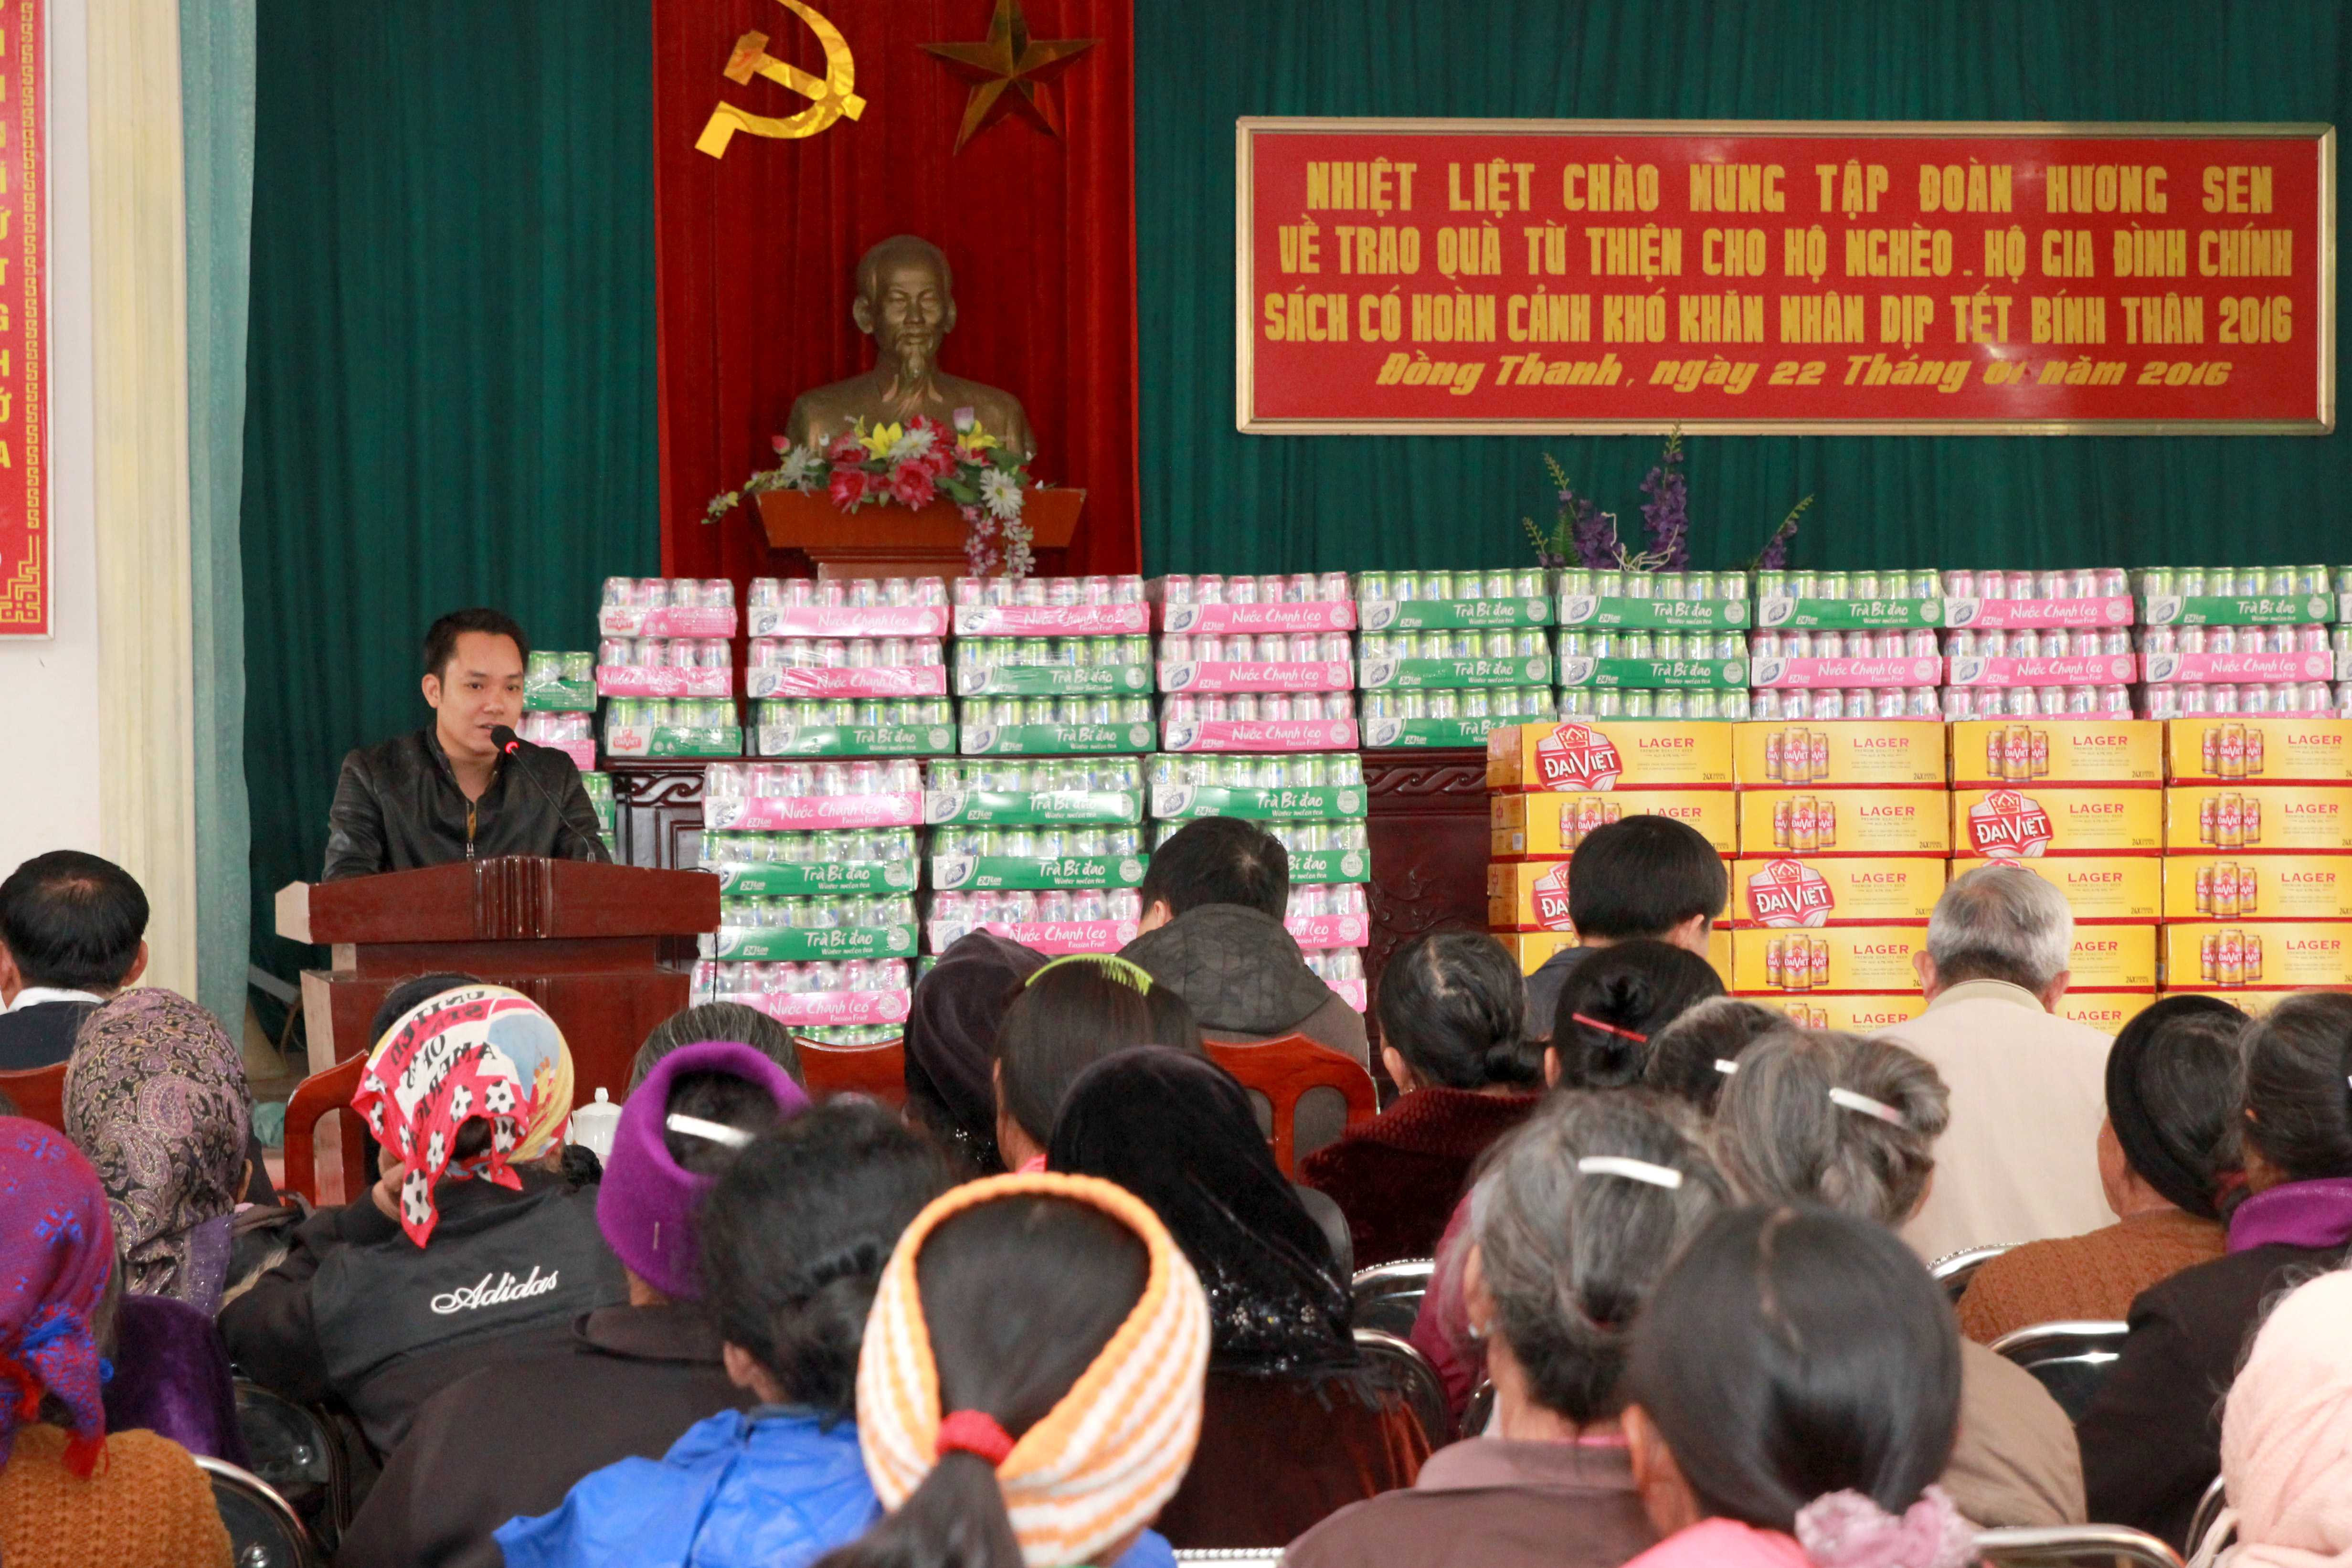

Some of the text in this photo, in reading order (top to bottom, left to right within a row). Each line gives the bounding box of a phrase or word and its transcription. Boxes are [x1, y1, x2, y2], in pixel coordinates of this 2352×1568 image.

[1307, 157, 1418, 217] NHIỆT
[1449, 158, 1535, 218] LIỆT
[1563, 156, 1659, 212] CHÀO
[1816, 160, 1889, 220] TẬP
[1919, 158, 2013, 213] ĐOÀN
[2046, 165, 2167, 213] HƯƠNG
[2203, 166, 2272, 213] SEN
[1279, 214, 1320, 273] VỀ
[1335, 226, 1420, 275] TRAO
[1437, 220, 1501, 280] QUÀ
[1524, 220, 1566, 275] TỪ
[1585, 223, 1682, 282] THIỆN
[1703, 228, 1766, 276] CHO
[1785, 224, 1827, 283] HỘ
[1846, 223, 1952, 277] NGHÈO
[1984, 225, 2026, 283] HỘ
[2042, 229, 2094, 277] GIA
[2113, 222, 2186, 276] ĐÌNH
[2199, 222, 2292, 276] CHÍNH
[1264, 284, 2292, 349] SÁCH CÓ HOÀN CẢNH KHÓ KHĂN NHÂN DỊP TẾT BÍNH THÂN 2016
[1377, 350, 2232, 395] Đồng Thanh, ngày 22 Tháng 01 năm 2016
[1454, 603, 1515, 617] Trà Bí đao
[1652, 602, 1712, 616] Trà Bí đao
[1849, 602, 1907, 617] Trà Bí đao
[2044, 604, 2077, 617] Chanh
[2237, 599, 2295, 614] Trà Bí đao
[1265, 609, 1300, 624] Chanh
[1263, 667, 1298, 681] Chanh
[1453, 661, 1513, 676] Trà Bí đao
[1651, 662, 1711, 677] Trà Bí đao
[1851, 662, 1885, 676] Chanh
[2049, 661, 2083, 674] Chanh
[1056, 728, 1116, 742] Trà Bí đao
[1265, 725, 1300, 739] Chanh
[1639, 739, 1694, 747] LAGER
[1854, 738, 1909, 747] LAGER
[2074, 736, 2127, 745] LAGER
[2288, 736, 2342, 744] LAGER
[1257, 791, 1322, 809] Trà Bí đao
[818, 803, 857, 817] Chanh
[1646, 808, 1701, 817] LAGER
[1860, 806, 1915, 816] LAGER
[2069, 804, 2124, 813] LAGER
[2285, 804, 2338, 813] LAGER
[1039, 860, 1105, 876] Trà Bí đao
[1303, 856, 1326, 870] đao
[802, 865, 870, 880] Trà Bí đao
[1851, 873, 1907, 882] LAGER
[2068, 873, 2122, 881] LAGER
[2281, 873, 2335, 881] LAGER
[805, 930, 873, 946] Trà Bí đao
[1045, 927, 1083, 940] Chanh
[1854, 945, 1908, 954] LAGER
[2286, 941, 2340, 950] LAGER
[806, 1000, 845, 1015] Chanh
[1853, 1014, 1908, 1023] LAGER
[2066, 1011, 2121, 1020] LAGER
[431, 1266, 559, 1314] Adidas
